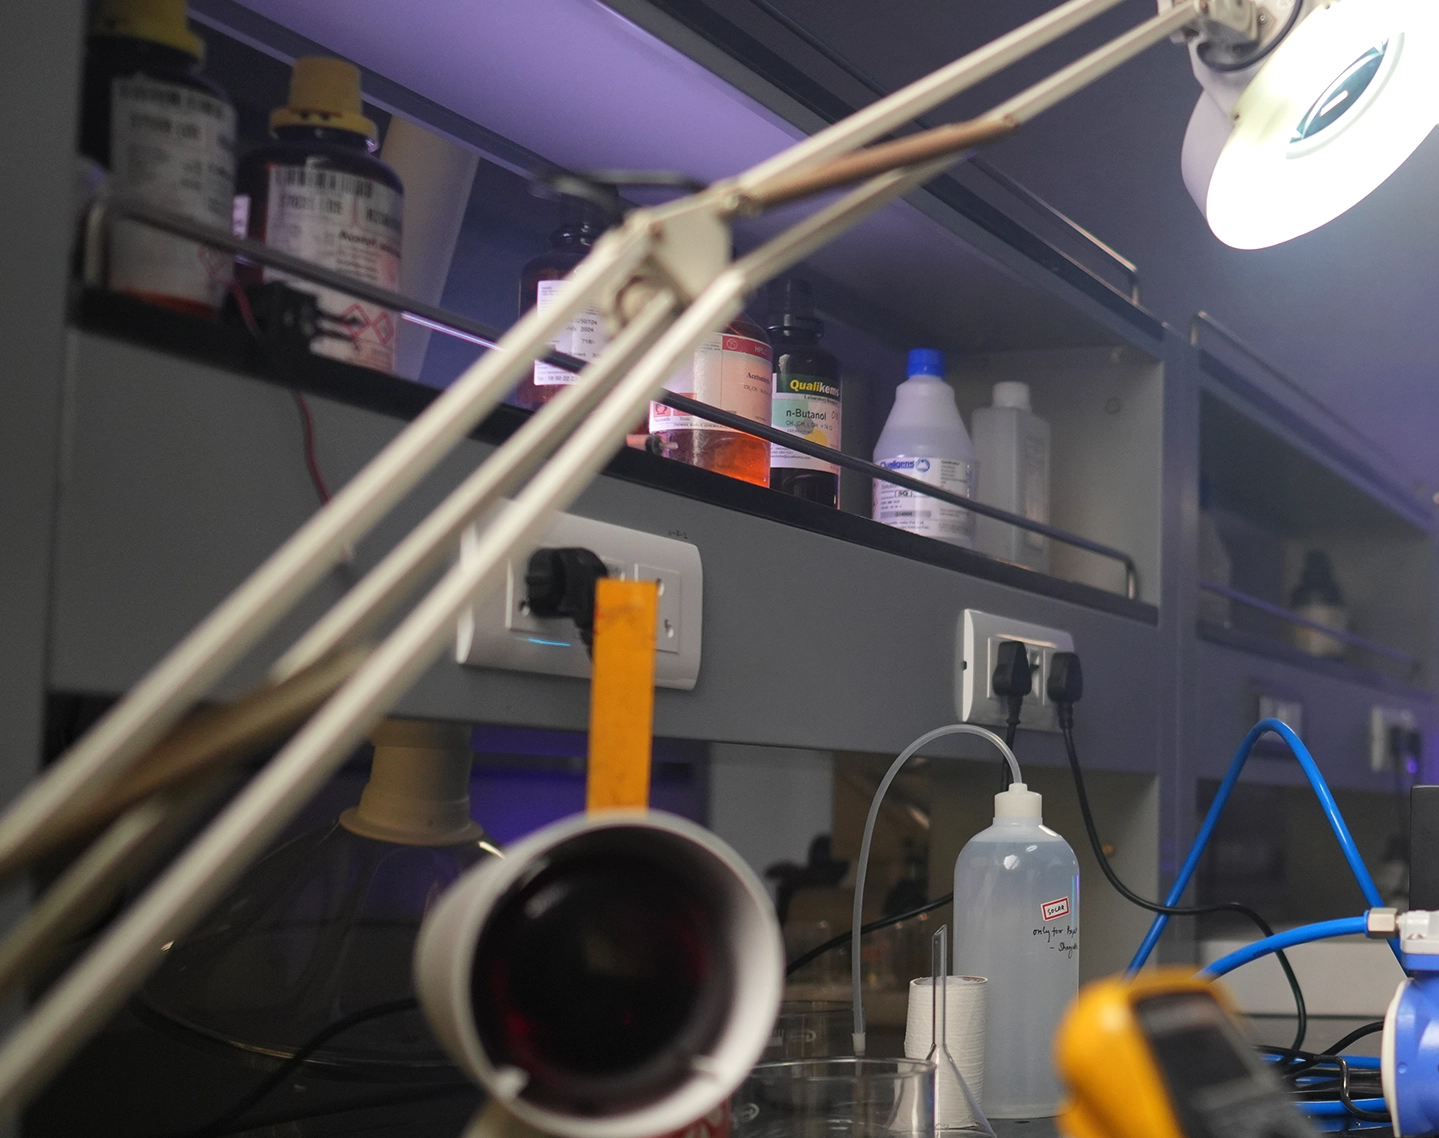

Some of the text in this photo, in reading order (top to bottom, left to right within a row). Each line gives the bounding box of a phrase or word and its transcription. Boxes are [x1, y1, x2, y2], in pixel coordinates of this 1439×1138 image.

[790, 379, 839, 397] Qualikems
[786, 408, 827, 420] n-Butanol
[1047, 904, 1065, 915] SOLAR
[1033, 926, 1050, 943] only
[1051, 927, 1063, 937] for
